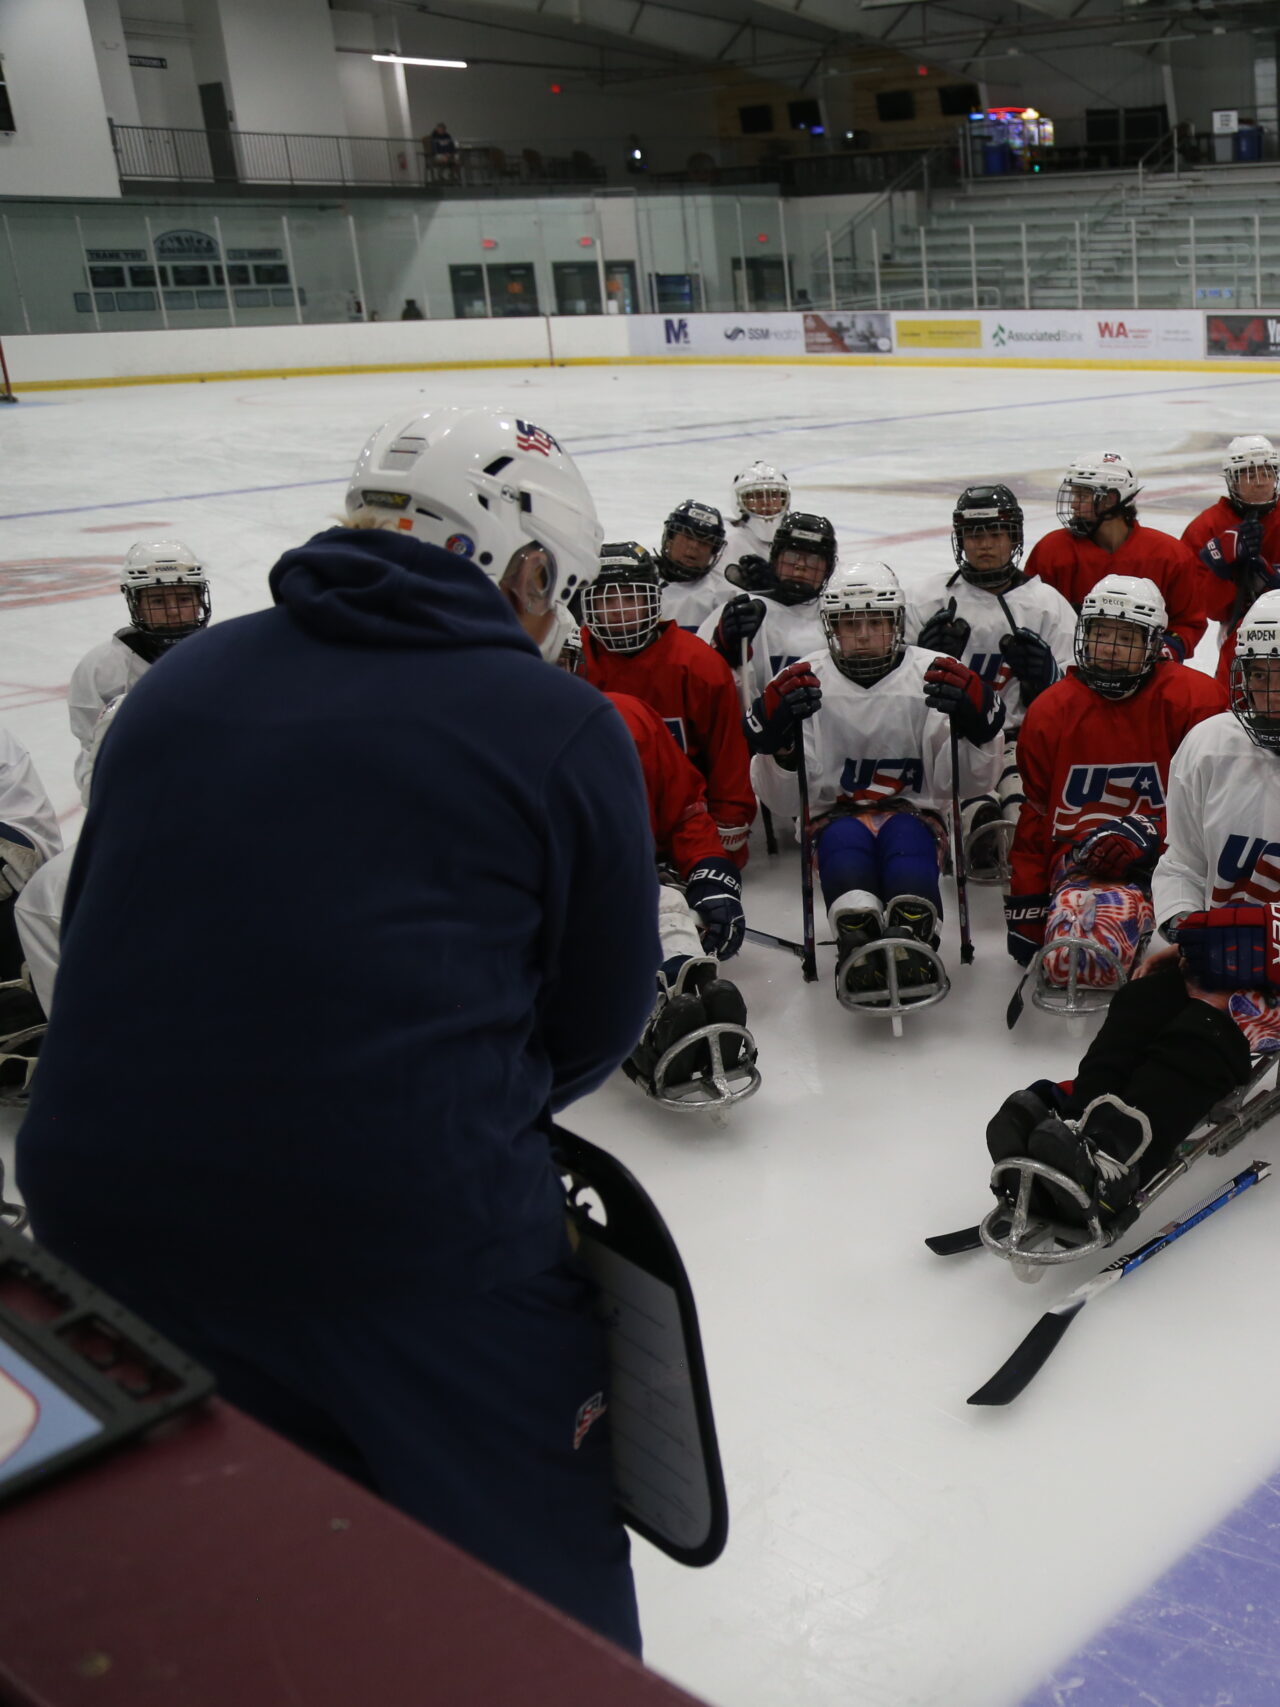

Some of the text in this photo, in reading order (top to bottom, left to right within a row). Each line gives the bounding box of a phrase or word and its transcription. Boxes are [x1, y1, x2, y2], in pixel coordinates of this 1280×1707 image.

[1246, 628, 1277, 643] KADEN
[840, 758, 924, 799] USA
[1062, 762, 1166, 814] USA
